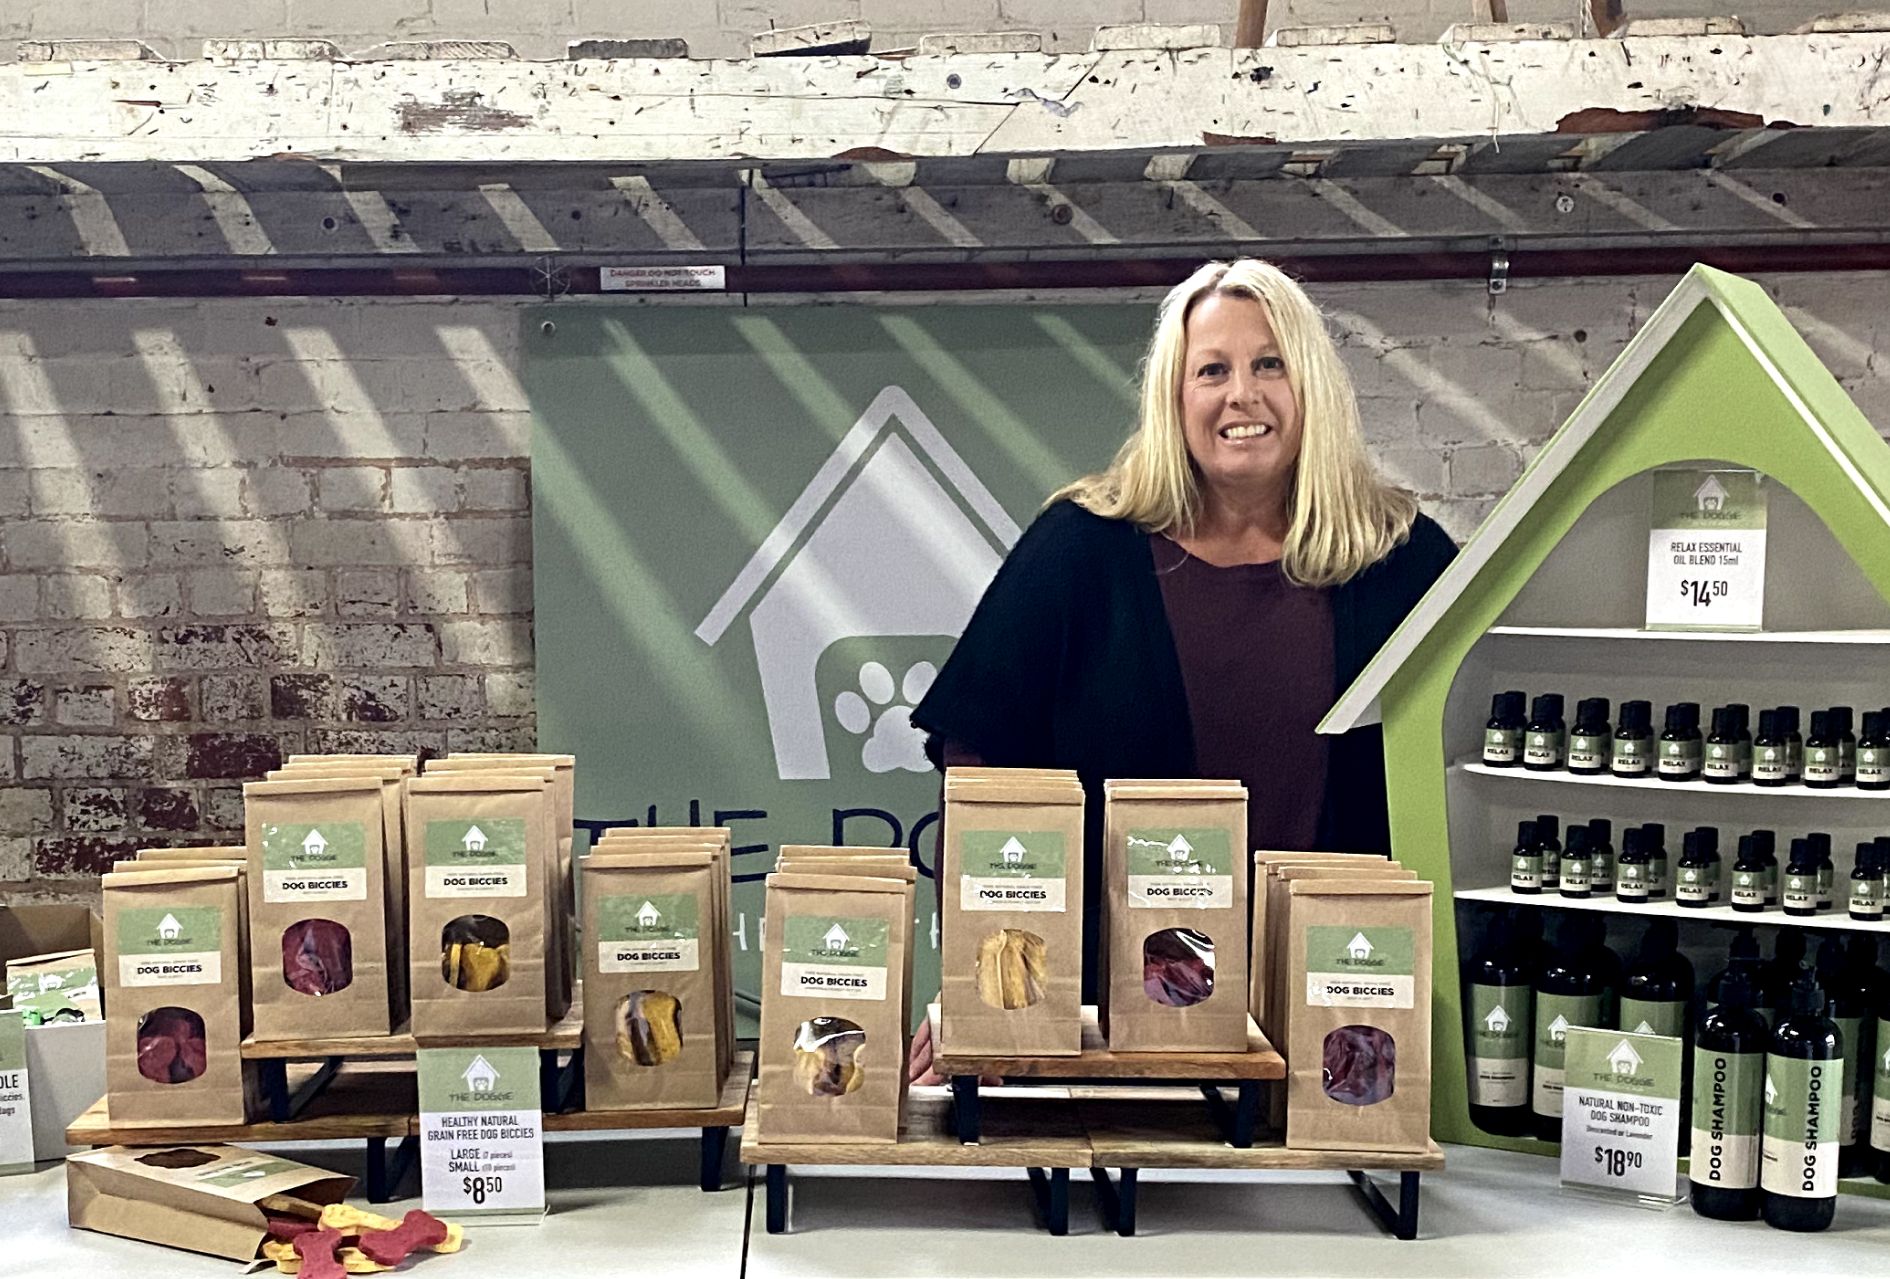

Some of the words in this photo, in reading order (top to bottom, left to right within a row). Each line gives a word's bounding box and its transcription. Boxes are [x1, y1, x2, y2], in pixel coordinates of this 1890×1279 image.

[683, 268, 716, 276] TOUCH
[1670, 542, 1697, 553] RELAX
[1699, 542, 1742, 553] ESSENTIAL
[1673, 554, 1686, 565] OIL
[1689, 554, 1716, 565] BLEND
[1719, 554, 1739, 565] 15ml
[1487, 747, 1509, 756] RELAX
[1617, 758, 1641, 766] RELAX
[282, 882, 305, 890] DOG
[308, 880, 348, 889] BICCIES
[443, 878, 466, 886] DOG
[469, 877, 508, 886] BICCIES
[980, 890, 1003, 899] DOG
[1006, 890, 1047, 899] BICCIES
[1147, 888, 1170, 896] DOG
[617, 953, 639, 961] DOG
[642, 952, 680, 960] BICCIES
[137, 966, 160, 974] DOG
[163, 964, 202, 974] BICCIES
[801, 976, 824, 985] DOG
[826, 977, 868, 987] BICCIES
[1326, 986, 1350, 994] DOG
[1353, 987, 1395, 996] BICCIES
[1593, 1072, 1612, 1082] THE
[449, 1092, 470, 1102] THE
[1711, 1057, 1727, 1141] SHAMPOO
[1579, 1096, 1614, 1111] NATURAL
[1617, 1100, 1663, 1116] NON-TOXIC
[1804, 1066, 1822, 1150] SHAMPOO
[441, 1116, 479, 1128] HEALTHY
[481, 1114, 518, 1127] NATURAL
[1590, 1110, 1607, 1122] DOG
[1609, 1112, 1650, 1127] SHAMPOO
[428, 1130, 455, 1141] GRAIN
[457, 1129, 478, 1140] FREE
[481, 1129, 498, 1140] DOG
[501, 1127, 534, 1139] BICCIES
[450, 1149, 481, 1160] LARGE
[448, 1161, 480, 1173] SMALL
[1709, 1145, 1723, 1182] DOG
[1802, 1154, 1817, 1192] DOG
